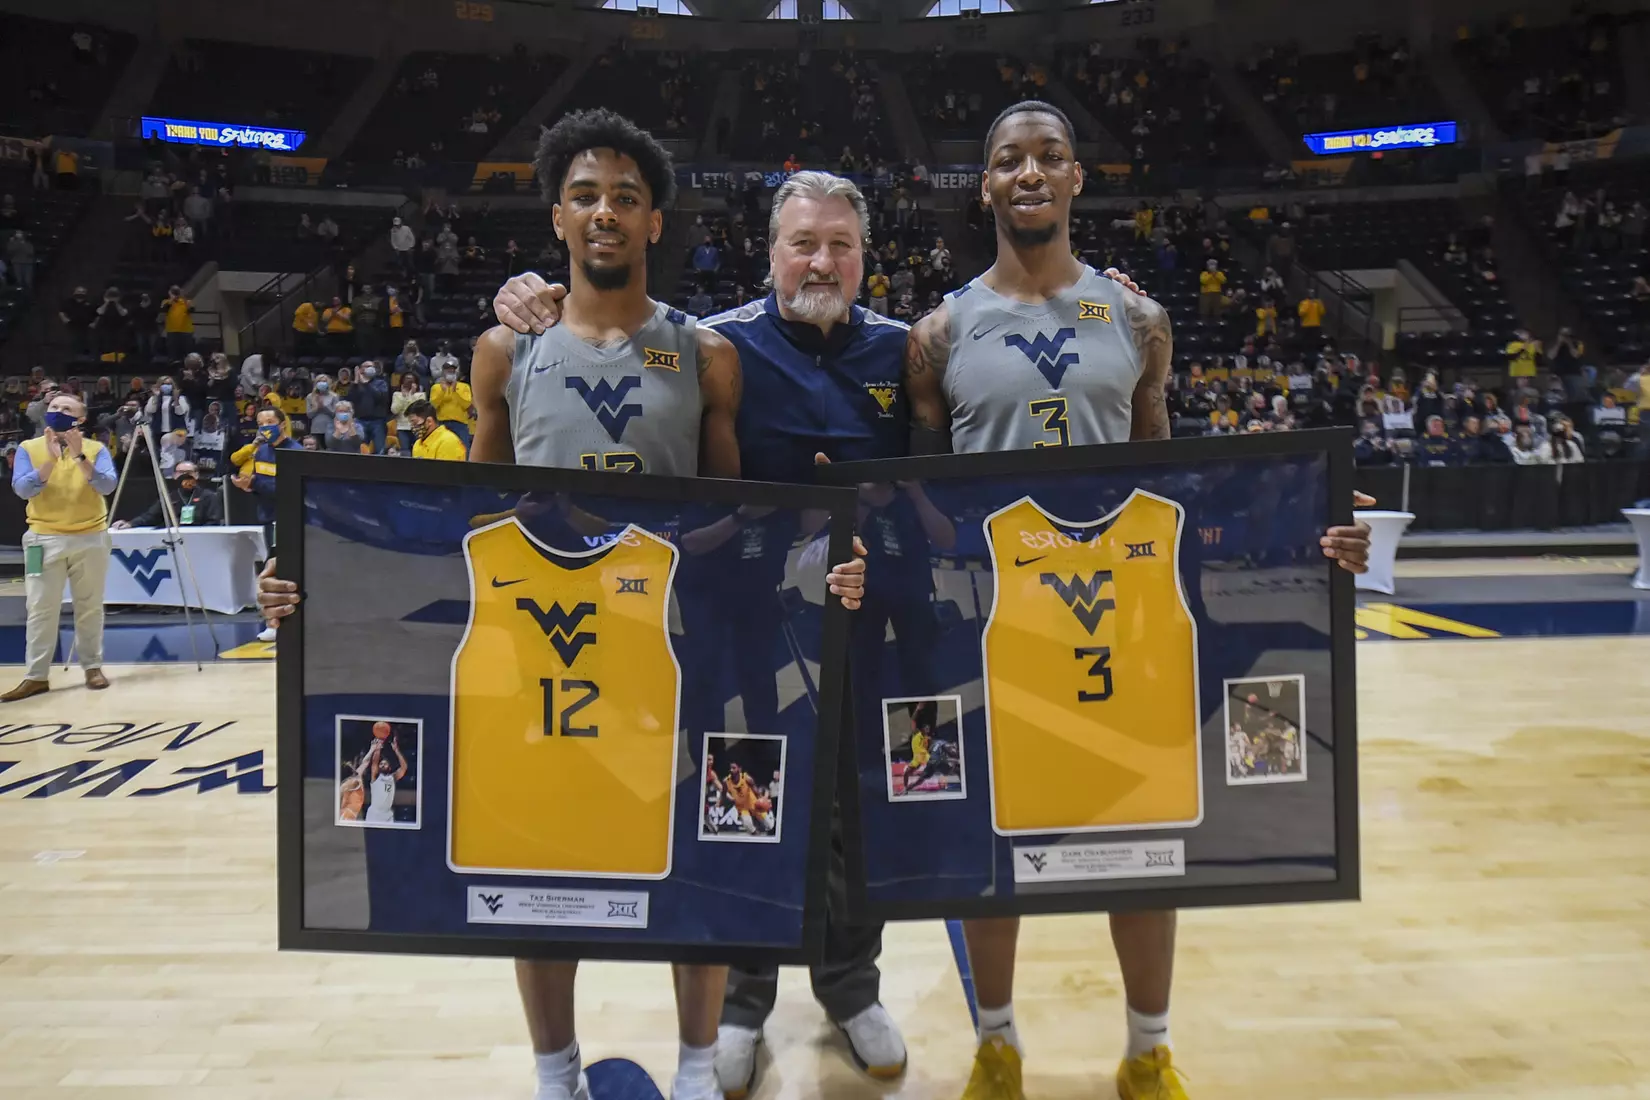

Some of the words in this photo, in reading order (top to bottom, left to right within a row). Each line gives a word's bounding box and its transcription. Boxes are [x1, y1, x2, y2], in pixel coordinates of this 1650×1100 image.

[165, 124, 197, 138] THANK
[199, 127, 219, 141] YOU
[219, 127, 288, 148] SENIORS
[1028, 398, 1072, 449] 3
[1074, 646, 1114, 702] 3
[539, 678, 599, 738] 12
